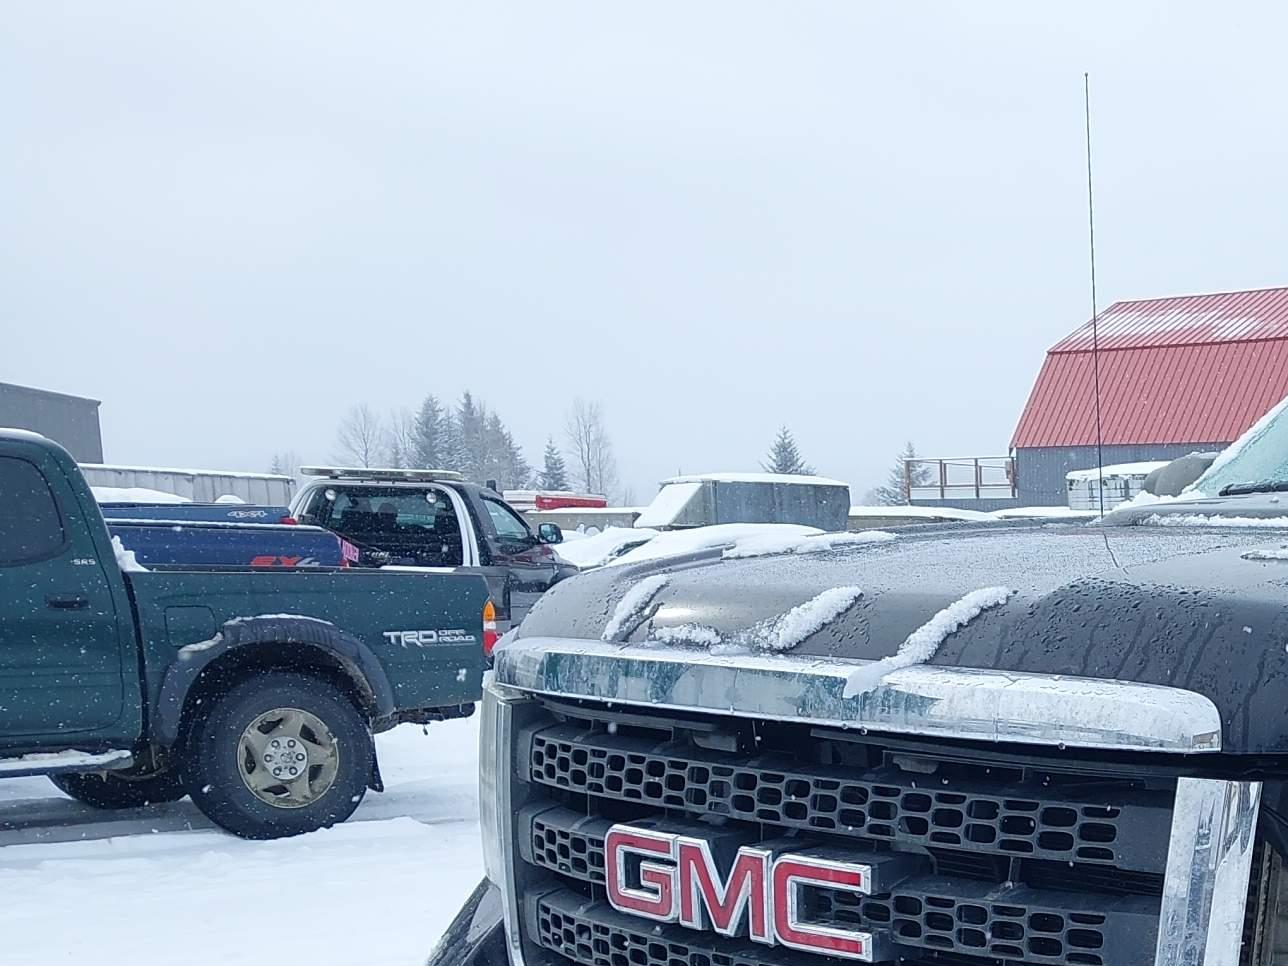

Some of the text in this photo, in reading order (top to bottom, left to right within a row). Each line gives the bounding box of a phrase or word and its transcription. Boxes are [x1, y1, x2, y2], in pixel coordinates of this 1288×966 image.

[382, 630, 437, 648] TRD
[438, 635, 476, 643] ROAD
[604, 823, 873, 962] GMC
